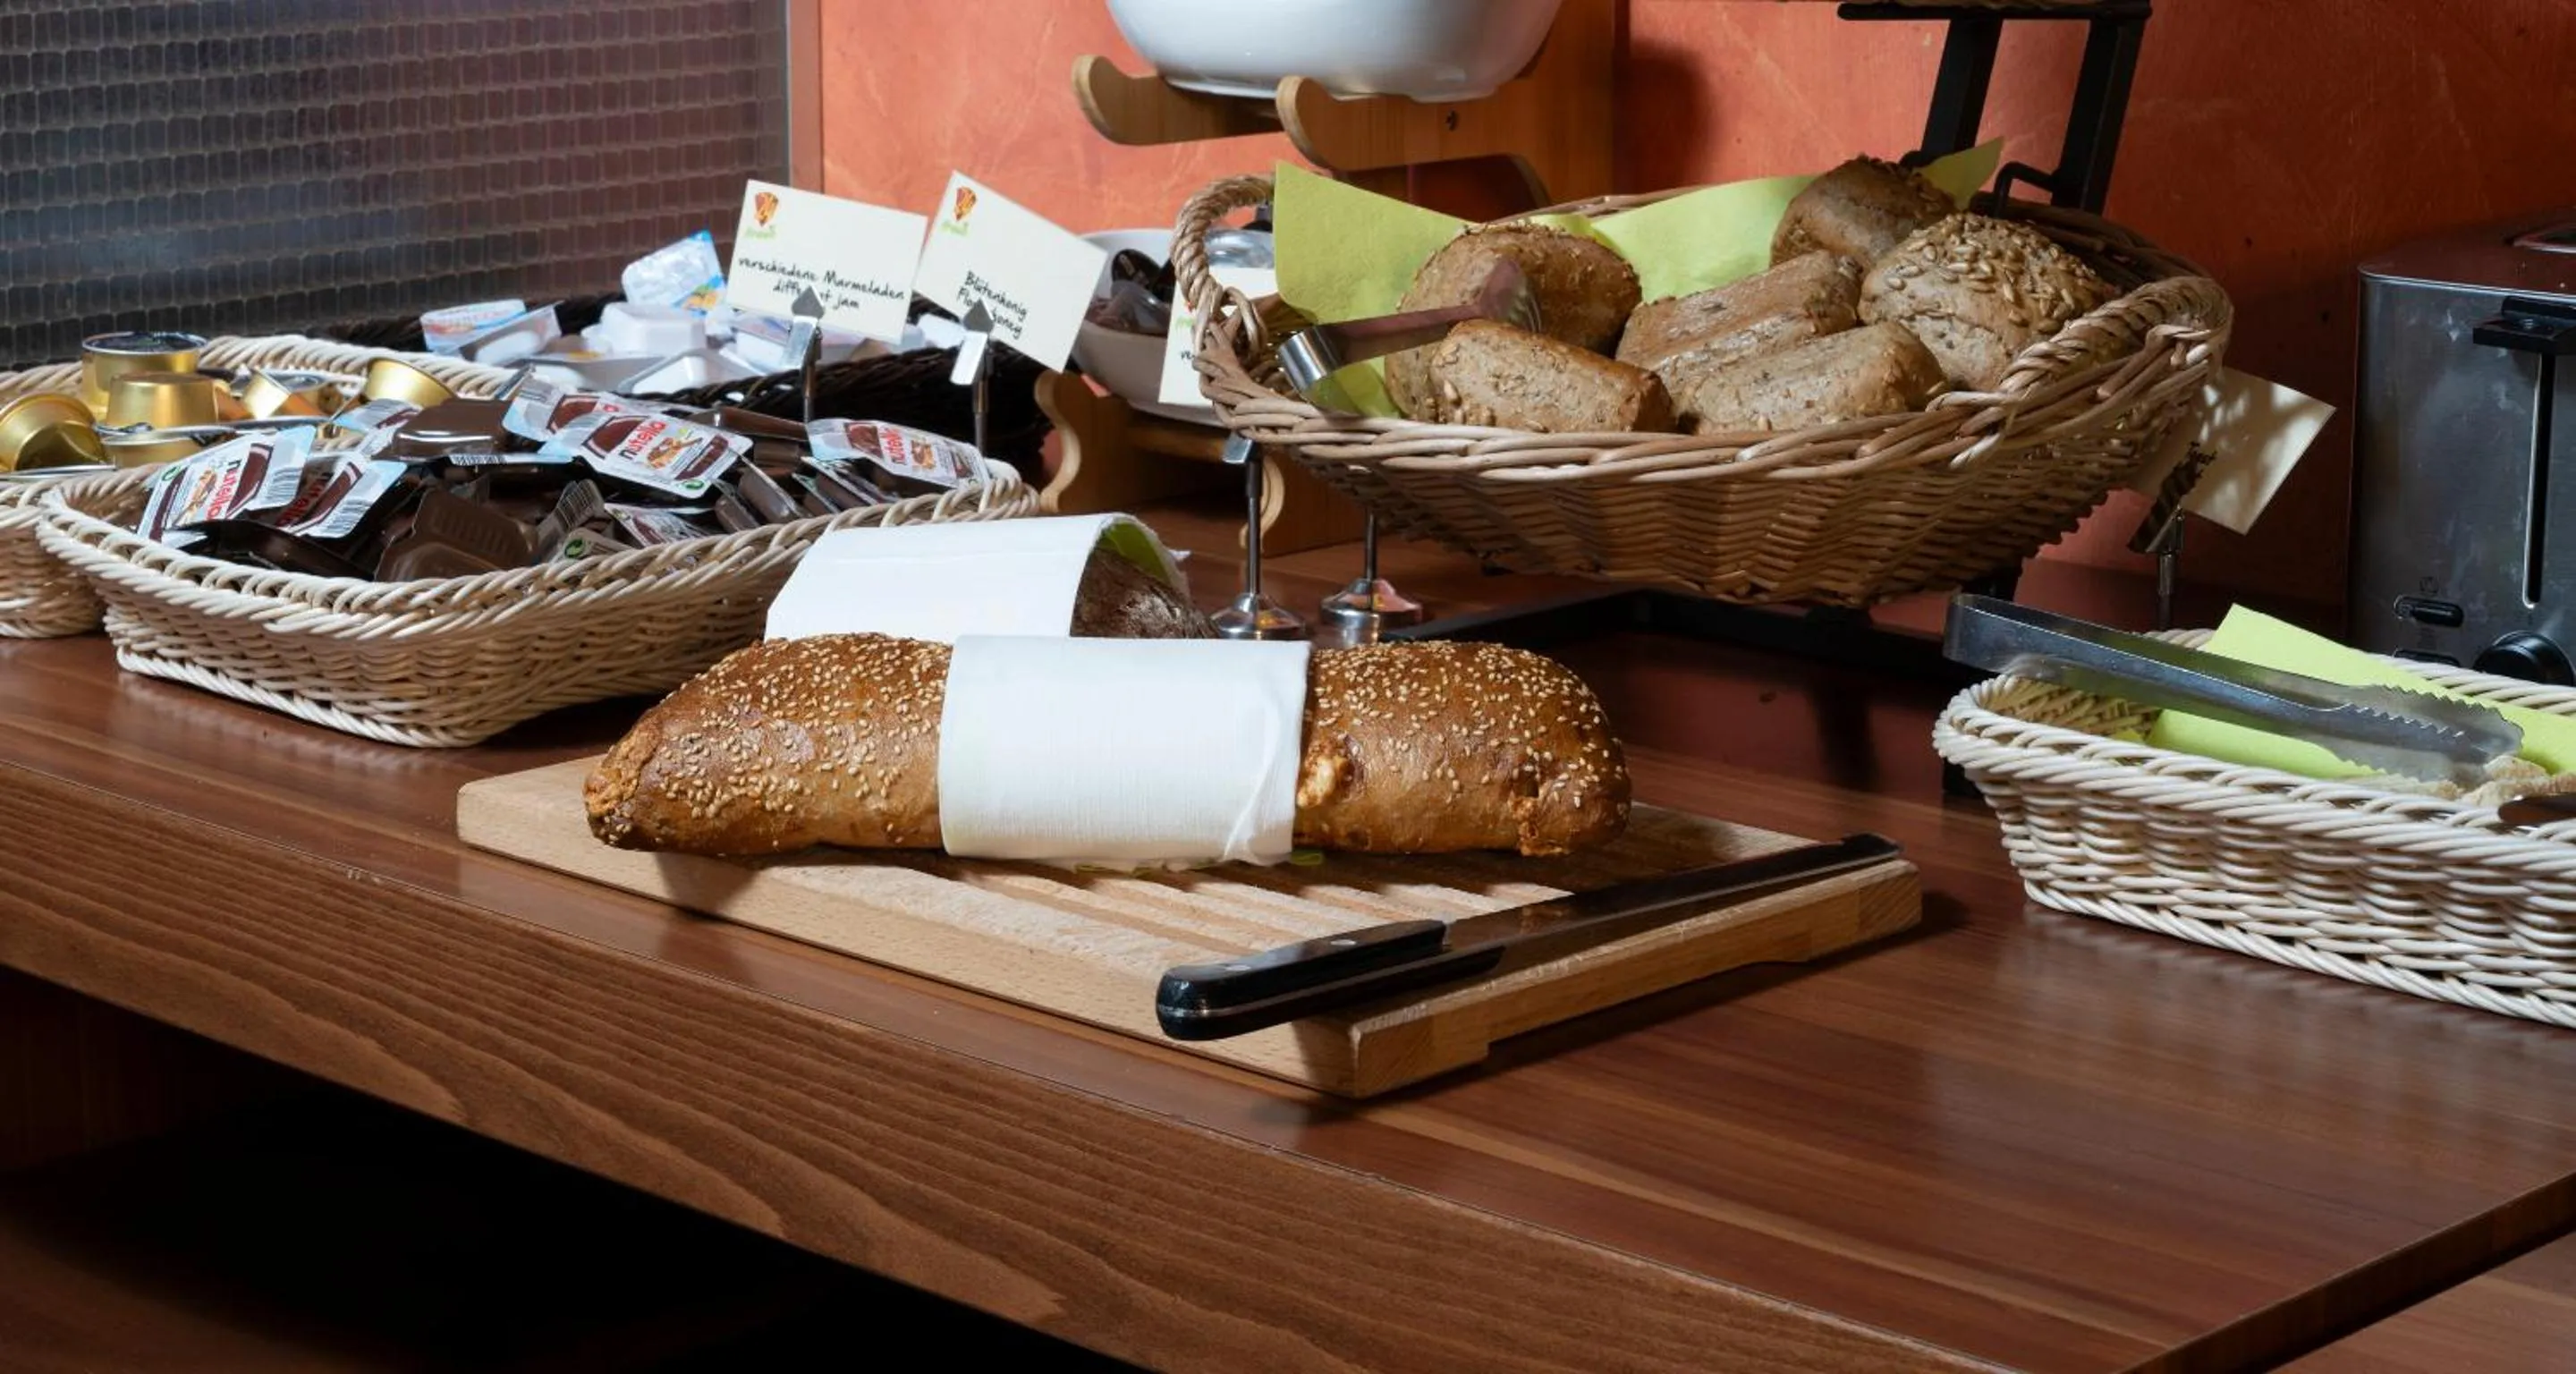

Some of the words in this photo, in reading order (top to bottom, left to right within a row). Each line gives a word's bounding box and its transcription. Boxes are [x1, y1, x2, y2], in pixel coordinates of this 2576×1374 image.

[738, 257, 818, 282] verschiedene
[824, 269, 905, 301] Marmeladen
[772, 279, 832, 302] diffent
[833, 293, 860, 311] jam
[617, 420, 666, 460] nutella
[880, 426, 907, 465] nutella
[206, 459, 242, 522] nutella
